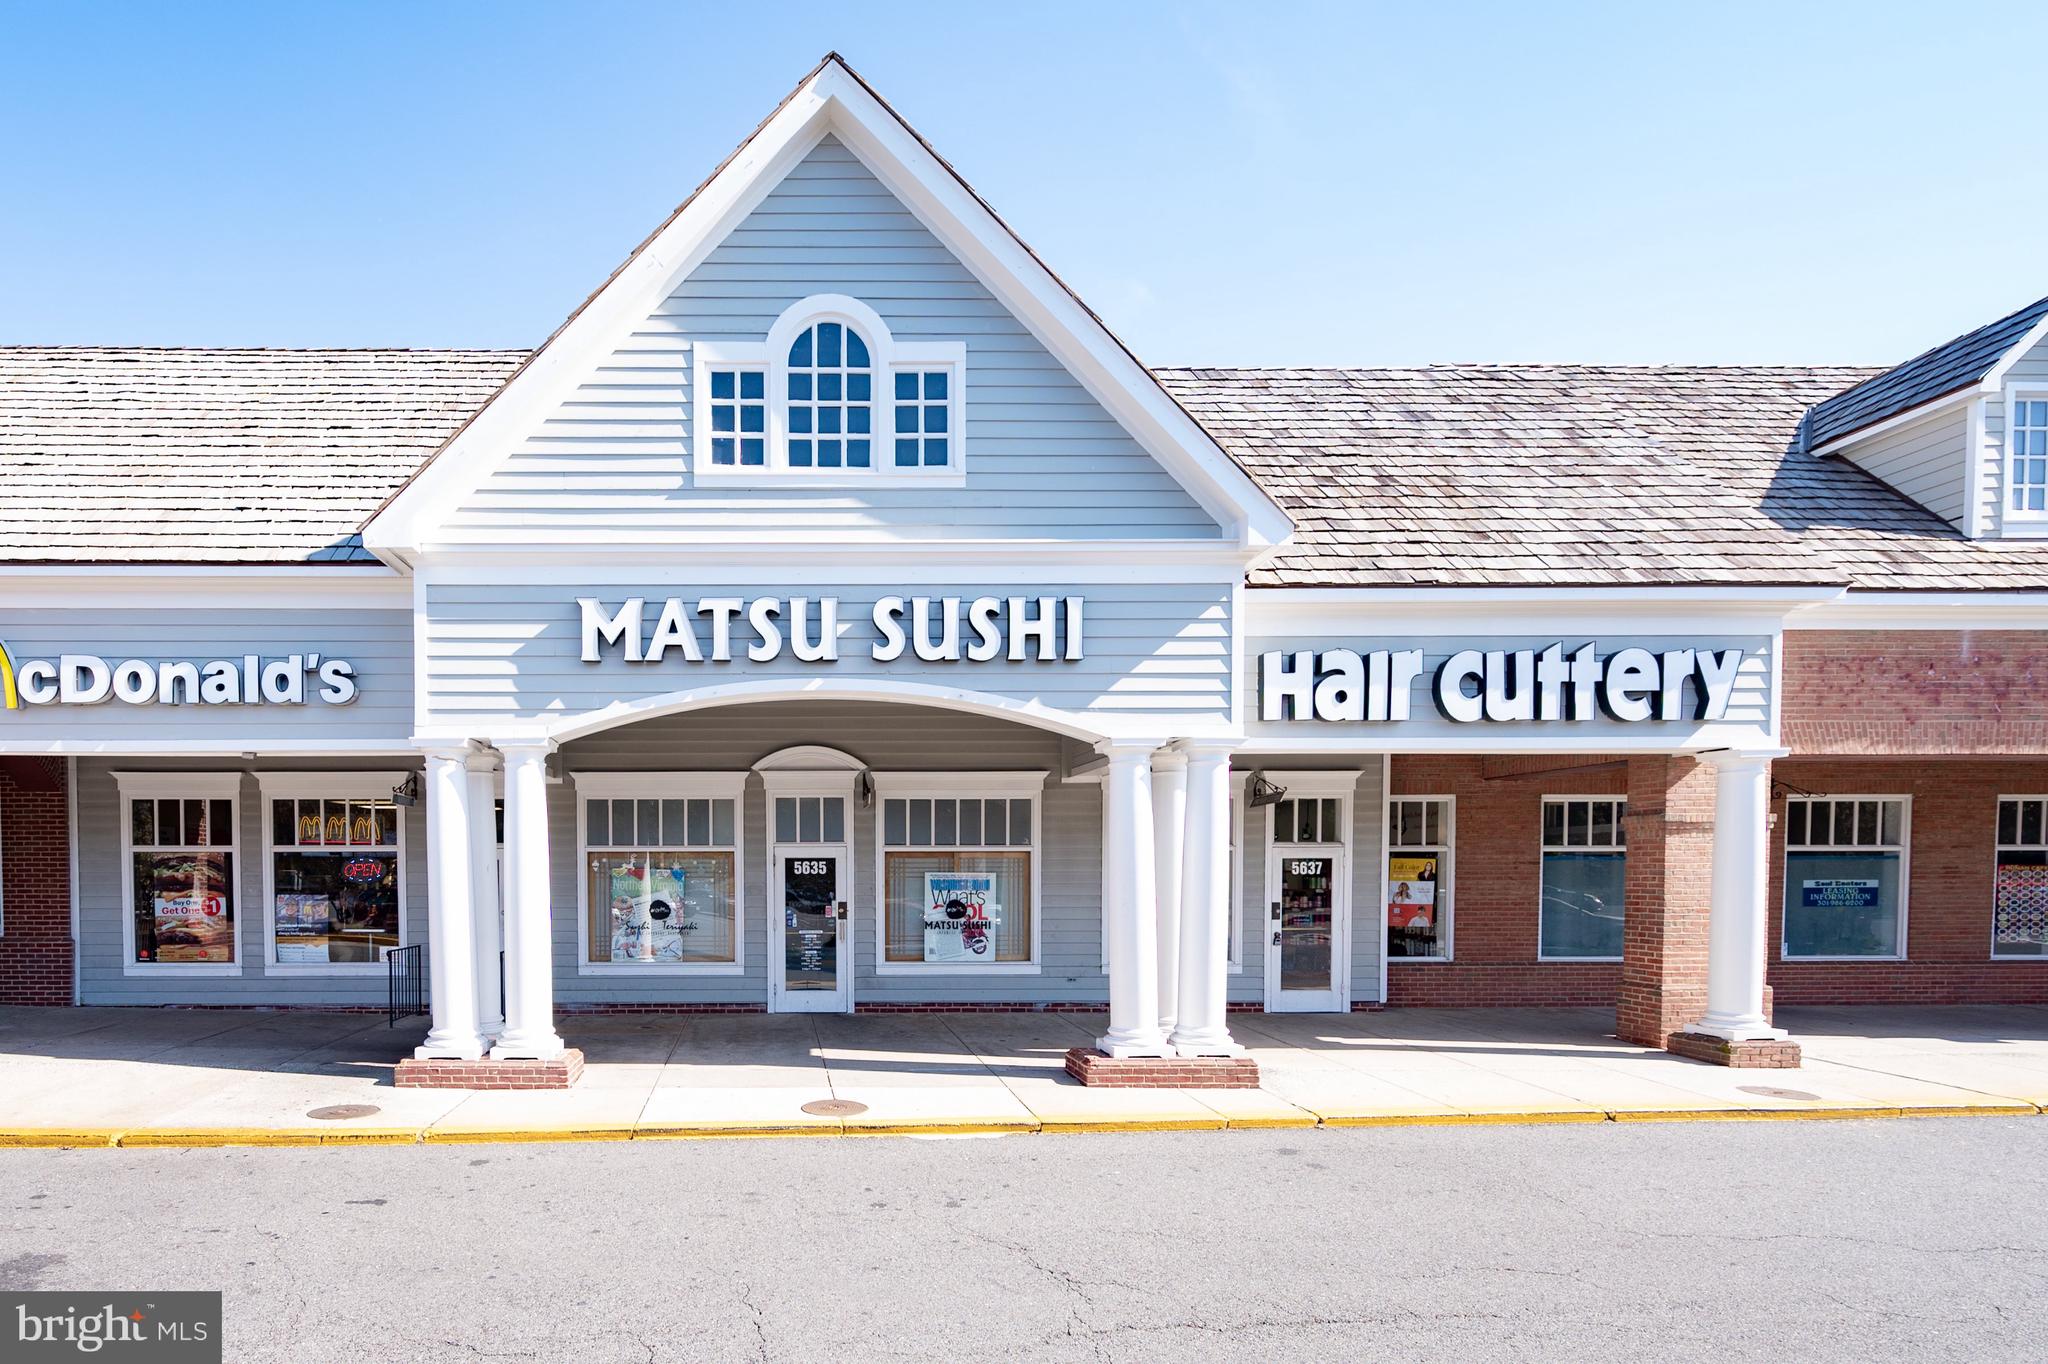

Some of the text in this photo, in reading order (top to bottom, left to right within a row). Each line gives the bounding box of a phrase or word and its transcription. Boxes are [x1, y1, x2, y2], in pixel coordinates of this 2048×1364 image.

[576, 595, 1085, 663] MATSU SUSHI
[1257, 640, 1744, 723] Hair cuttery
[344, 863, 382, 877] OPEN
[794, 861, 827, 875] 5635
[1291, 861, 1323, 875] 5637
[1810, 893, 1872, 901] INFORMATION
[161, 907, 179, 915] Get
[625, 920, 699, 933] Sushi Teriyaki
[925, 921, 992, 930] MATSU SUSHI
